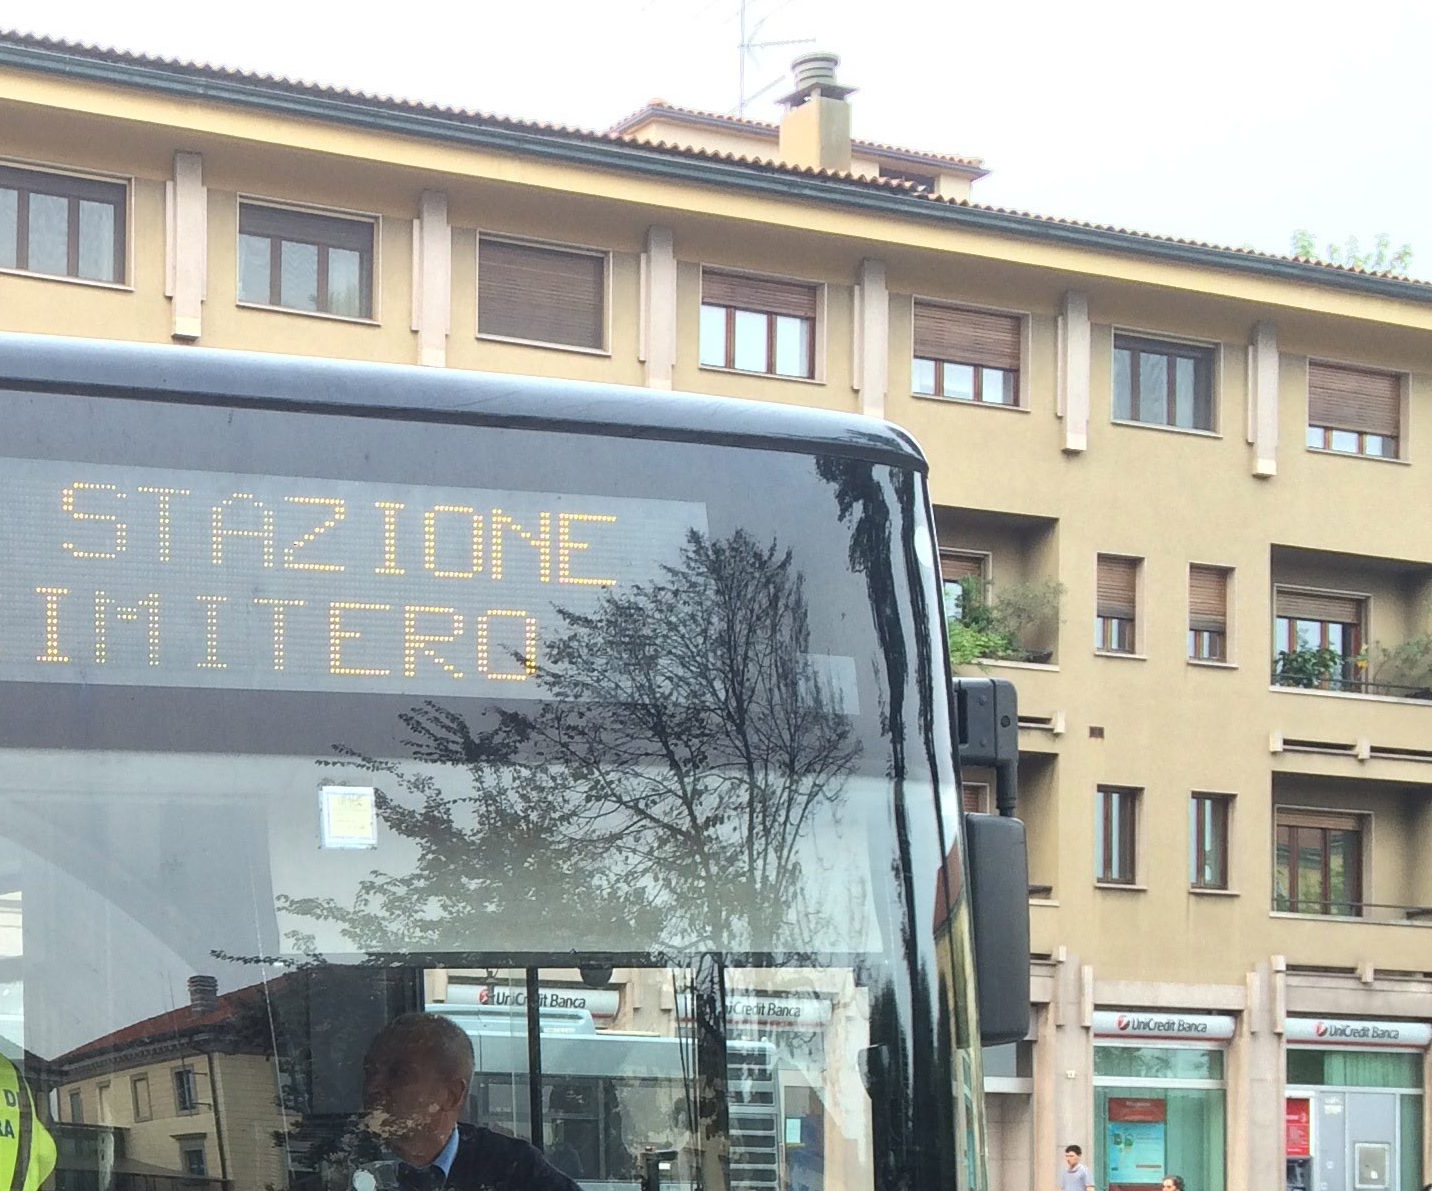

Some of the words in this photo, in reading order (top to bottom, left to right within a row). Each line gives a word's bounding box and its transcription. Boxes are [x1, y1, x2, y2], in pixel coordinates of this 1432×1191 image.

[61, 479, 619, 587] STAZIONE
[549, 993, 586, 1009] Banca
[767, 1002, 801, 1018] Banca
[1131, 1018, 1176, 1032] UniCredit
[1177, 1019, 1208, 1033] Banca
[1329, 1024, 1370, 1038] UniCredit
[1371, 1026, 1400, 1040] Banca
